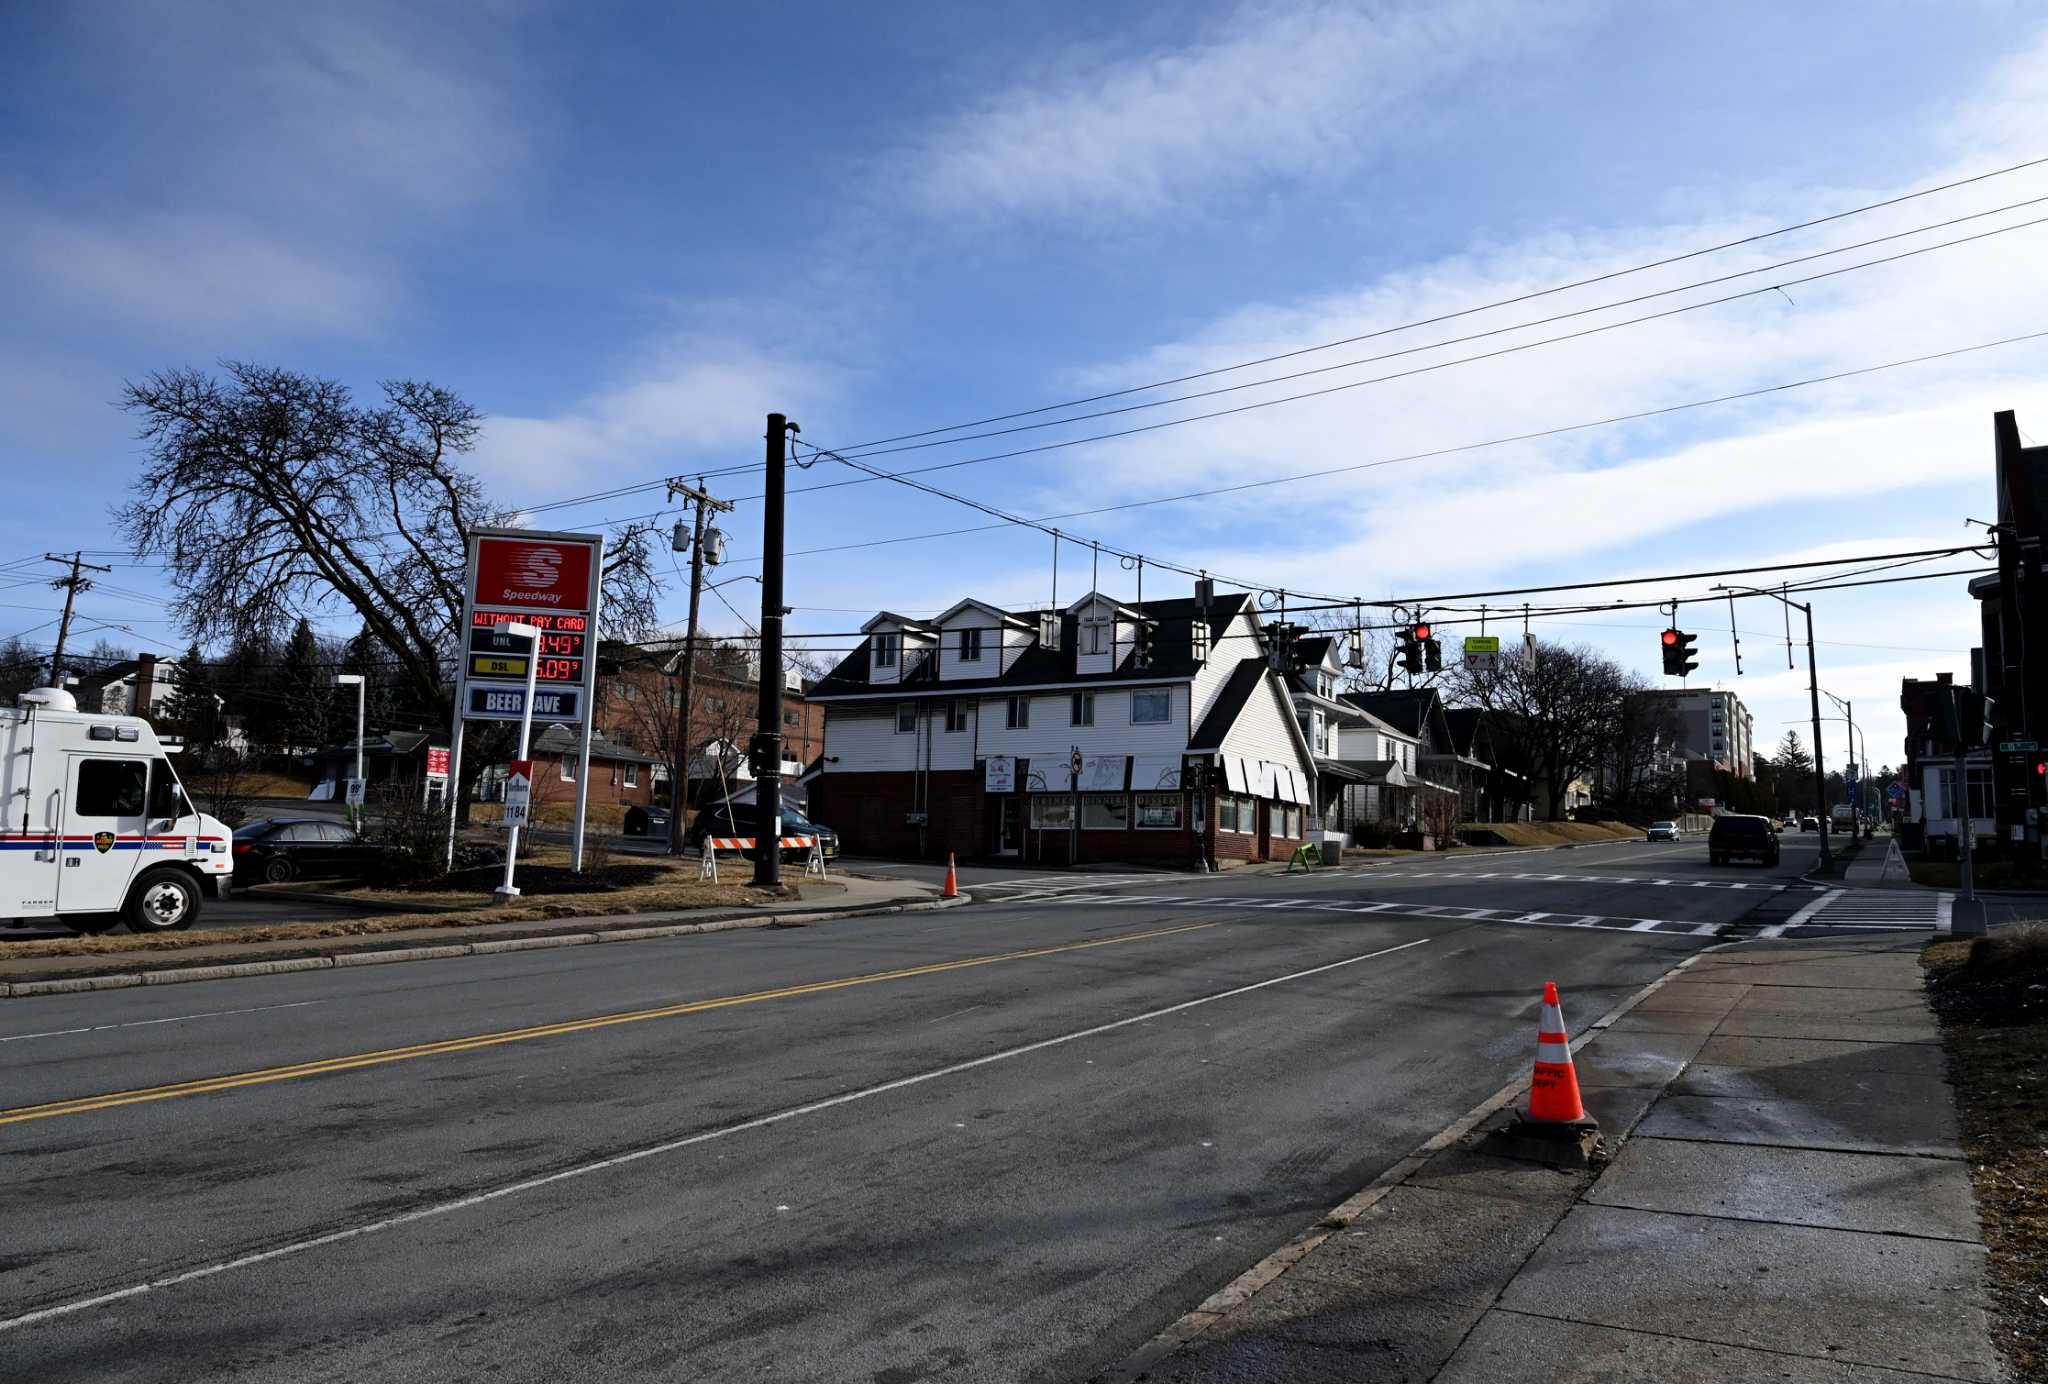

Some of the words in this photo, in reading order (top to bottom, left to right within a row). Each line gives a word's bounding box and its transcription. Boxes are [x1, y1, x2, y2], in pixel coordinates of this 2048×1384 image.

[502, 588, 563, 604] Speedway
[474, 612, 527, 626] WITHOUT
[530, 615, 552, 629] PAY
[556, 617, 586, 631] CARD
[492, 636, 512, 647] UNL
[491, 661, 510, 671] DSL
[486, 692, 522, 711] BEER
[533, 696, 561, 713] AVE
[506, 805, 526, 819] 1184
